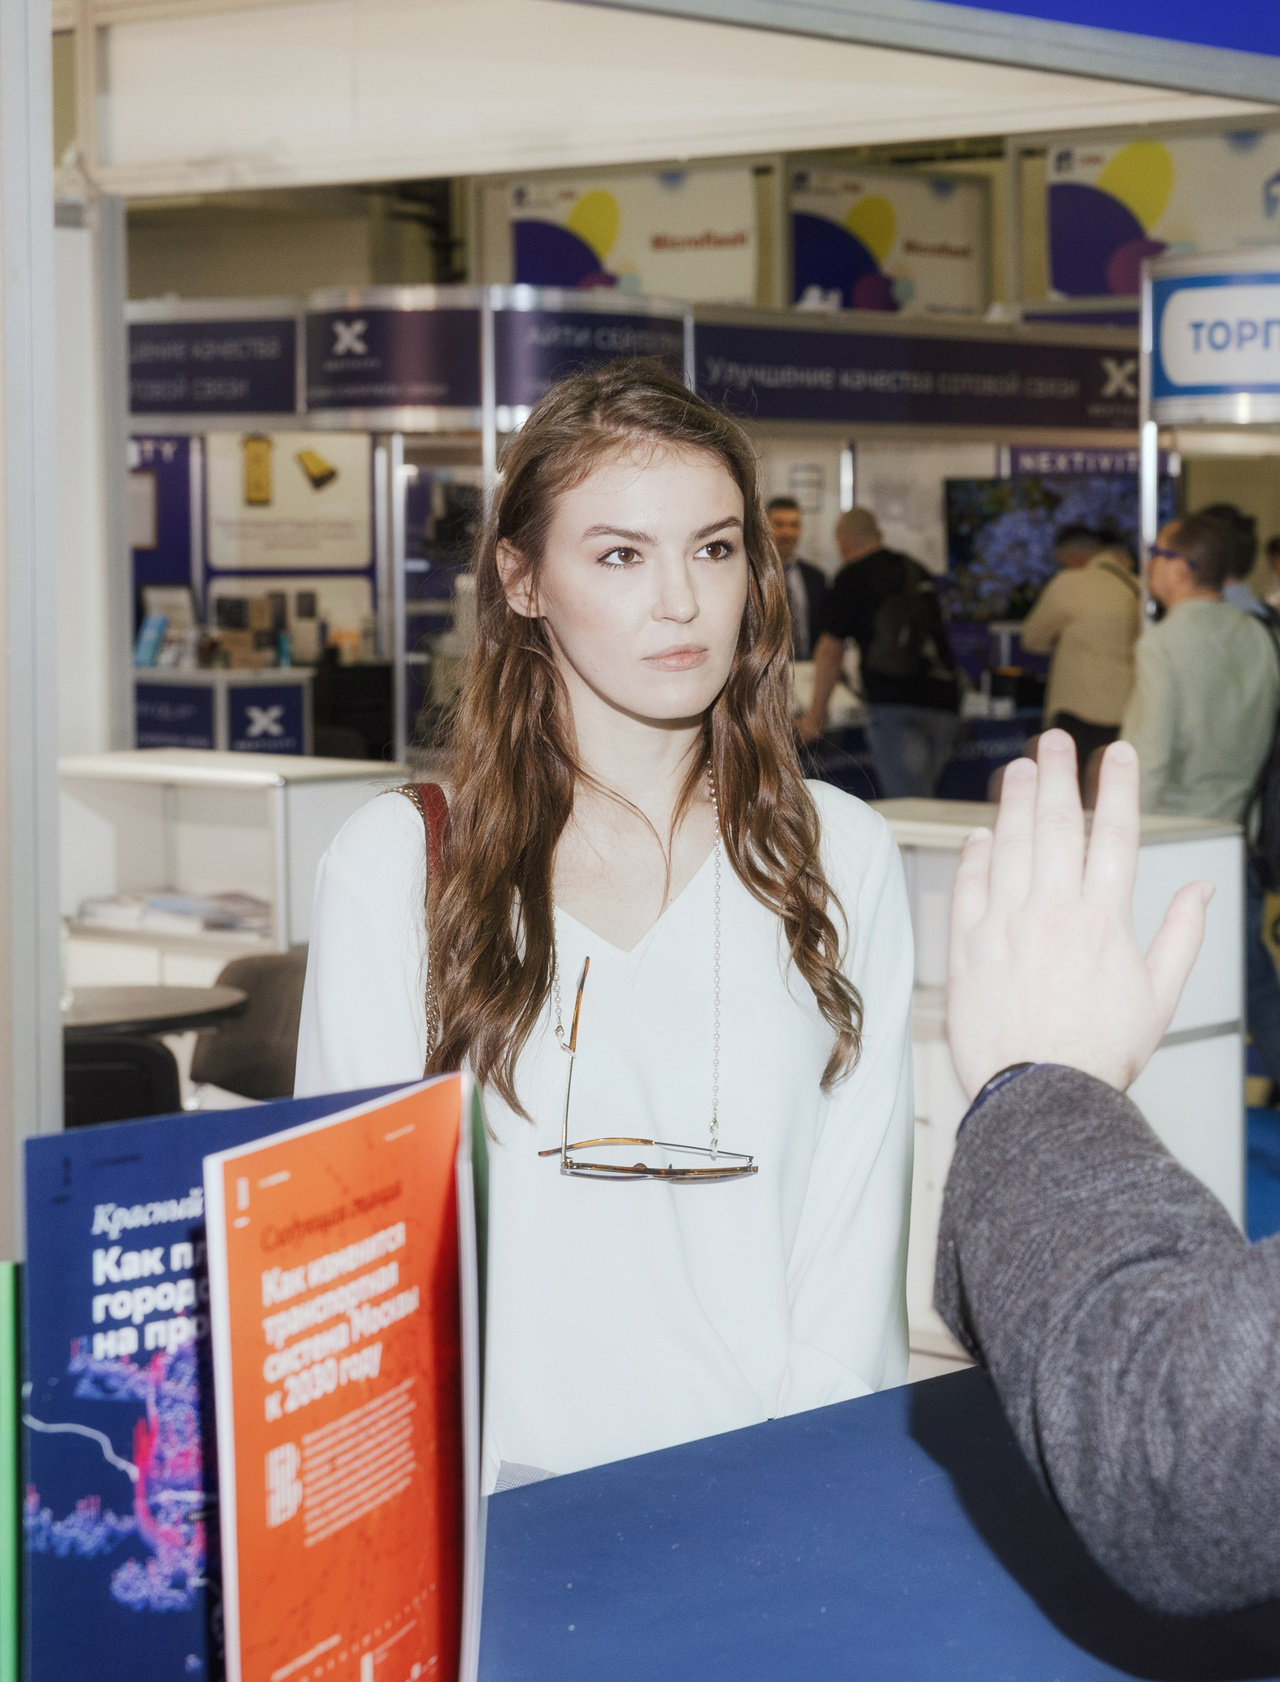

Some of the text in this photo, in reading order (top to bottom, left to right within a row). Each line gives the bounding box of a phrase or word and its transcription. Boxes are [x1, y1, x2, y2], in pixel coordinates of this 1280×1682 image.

[1020, 453, 1137, 472] NEXTIVIT
[92, 1245, 166, 1287] Как
[261, 1266, 307, 1308] Как
[92, 1326, 139, 1360] на
[264, 1391, 283, 1423] к
